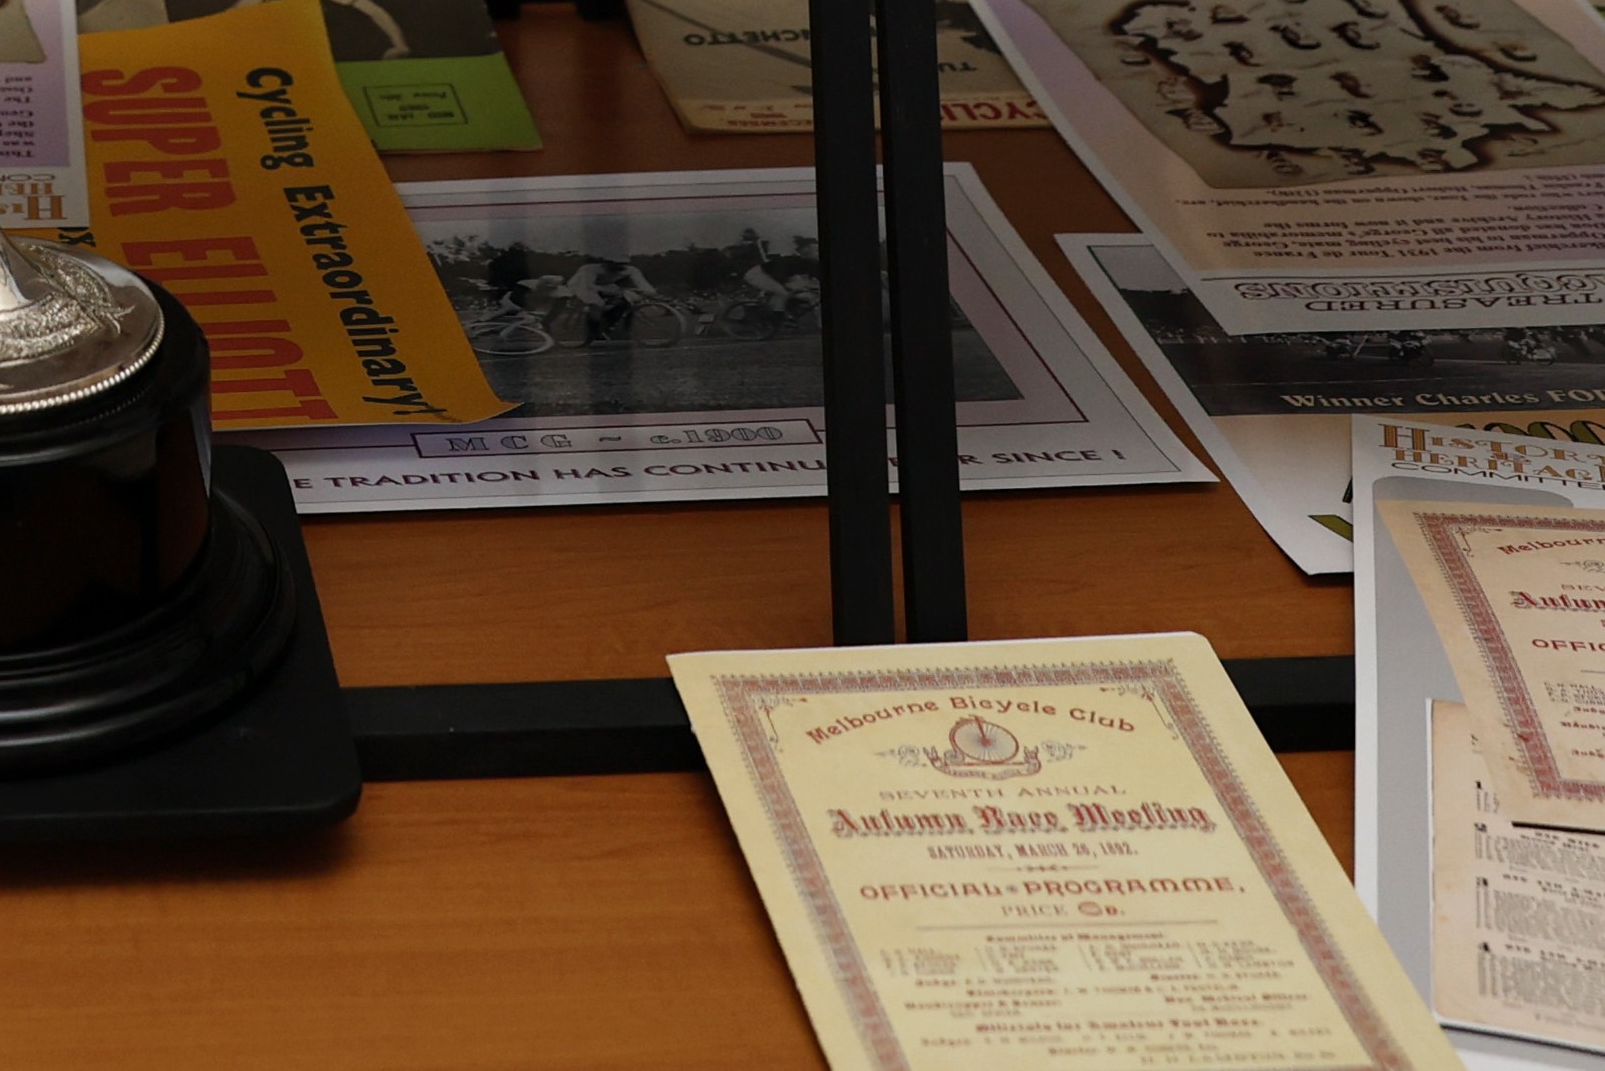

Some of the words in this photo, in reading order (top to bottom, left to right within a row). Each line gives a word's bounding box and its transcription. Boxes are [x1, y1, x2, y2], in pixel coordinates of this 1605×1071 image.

[236, 66, 315, 171] Cycling
[81, 66, 237, 217] SUPER
[1235, 274, 1605, 300] CQUISITIONS
[1305, 295, 1604, 311] TREASURED
[1279, 392, 1405, 408] Winner
[1414, 389, 1540, 407] Charles
[323, 467, 541, 490] TRADITION
[554, 464, 633, 482] HAS
[994, 449, 1103, 466] SINCE
[806, 698, 939, 746] Melbourne
[949, 695, 1057, 717] Bicycle
[1070, 707, 1136, 733] Club
[878, 788, 1005, 803] SEVENTH
[1017, 784, 1128, 798] ANNUAL
[825, 806, 967, 838] Autumn
[971, 804, 1060, 835] Race
[1066, 801, 1218, 833] Meeting
[927, 844, 1013, 861] SATURDAY,
[1017, 843, 1070, 859] MARCH
[859, 882, 1004, 902] OFFICIAL
[1001, 903, 1069, 918] PRICE
